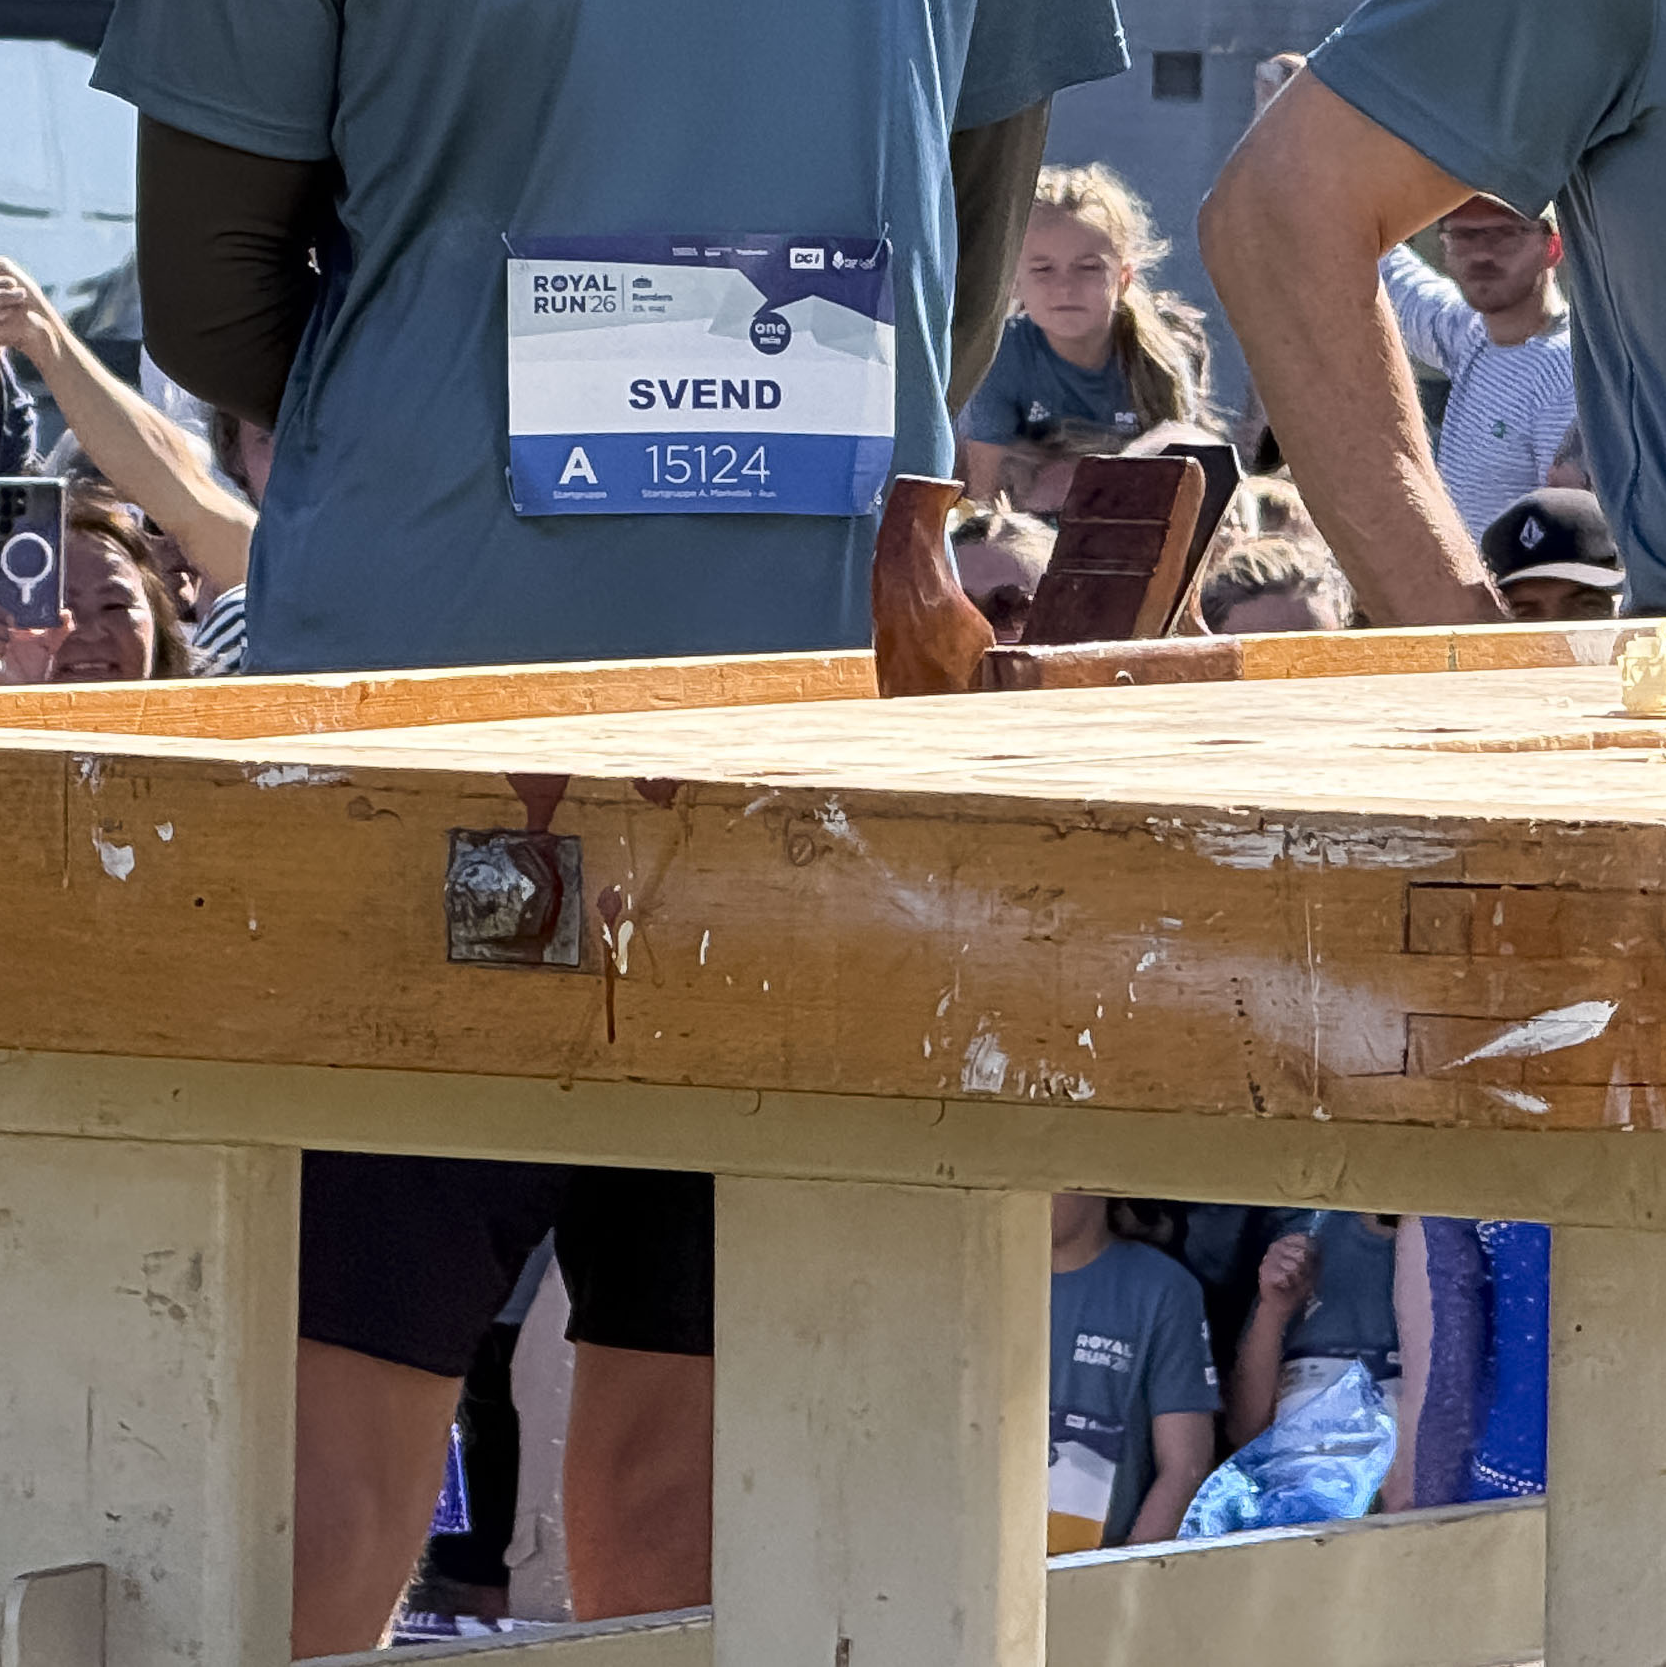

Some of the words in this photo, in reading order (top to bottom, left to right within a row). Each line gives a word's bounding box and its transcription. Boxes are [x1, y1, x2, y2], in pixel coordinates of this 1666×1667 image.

[533, 273, 617, 293] ROYAL
[755, 323, 786, 335] one
[628, 378, 782, 410] SVEND
[558, 446, 599, 485] A
[644, 444, 771, 485] 15124
[1076, 1334, 1134, 1358] ROYAL
